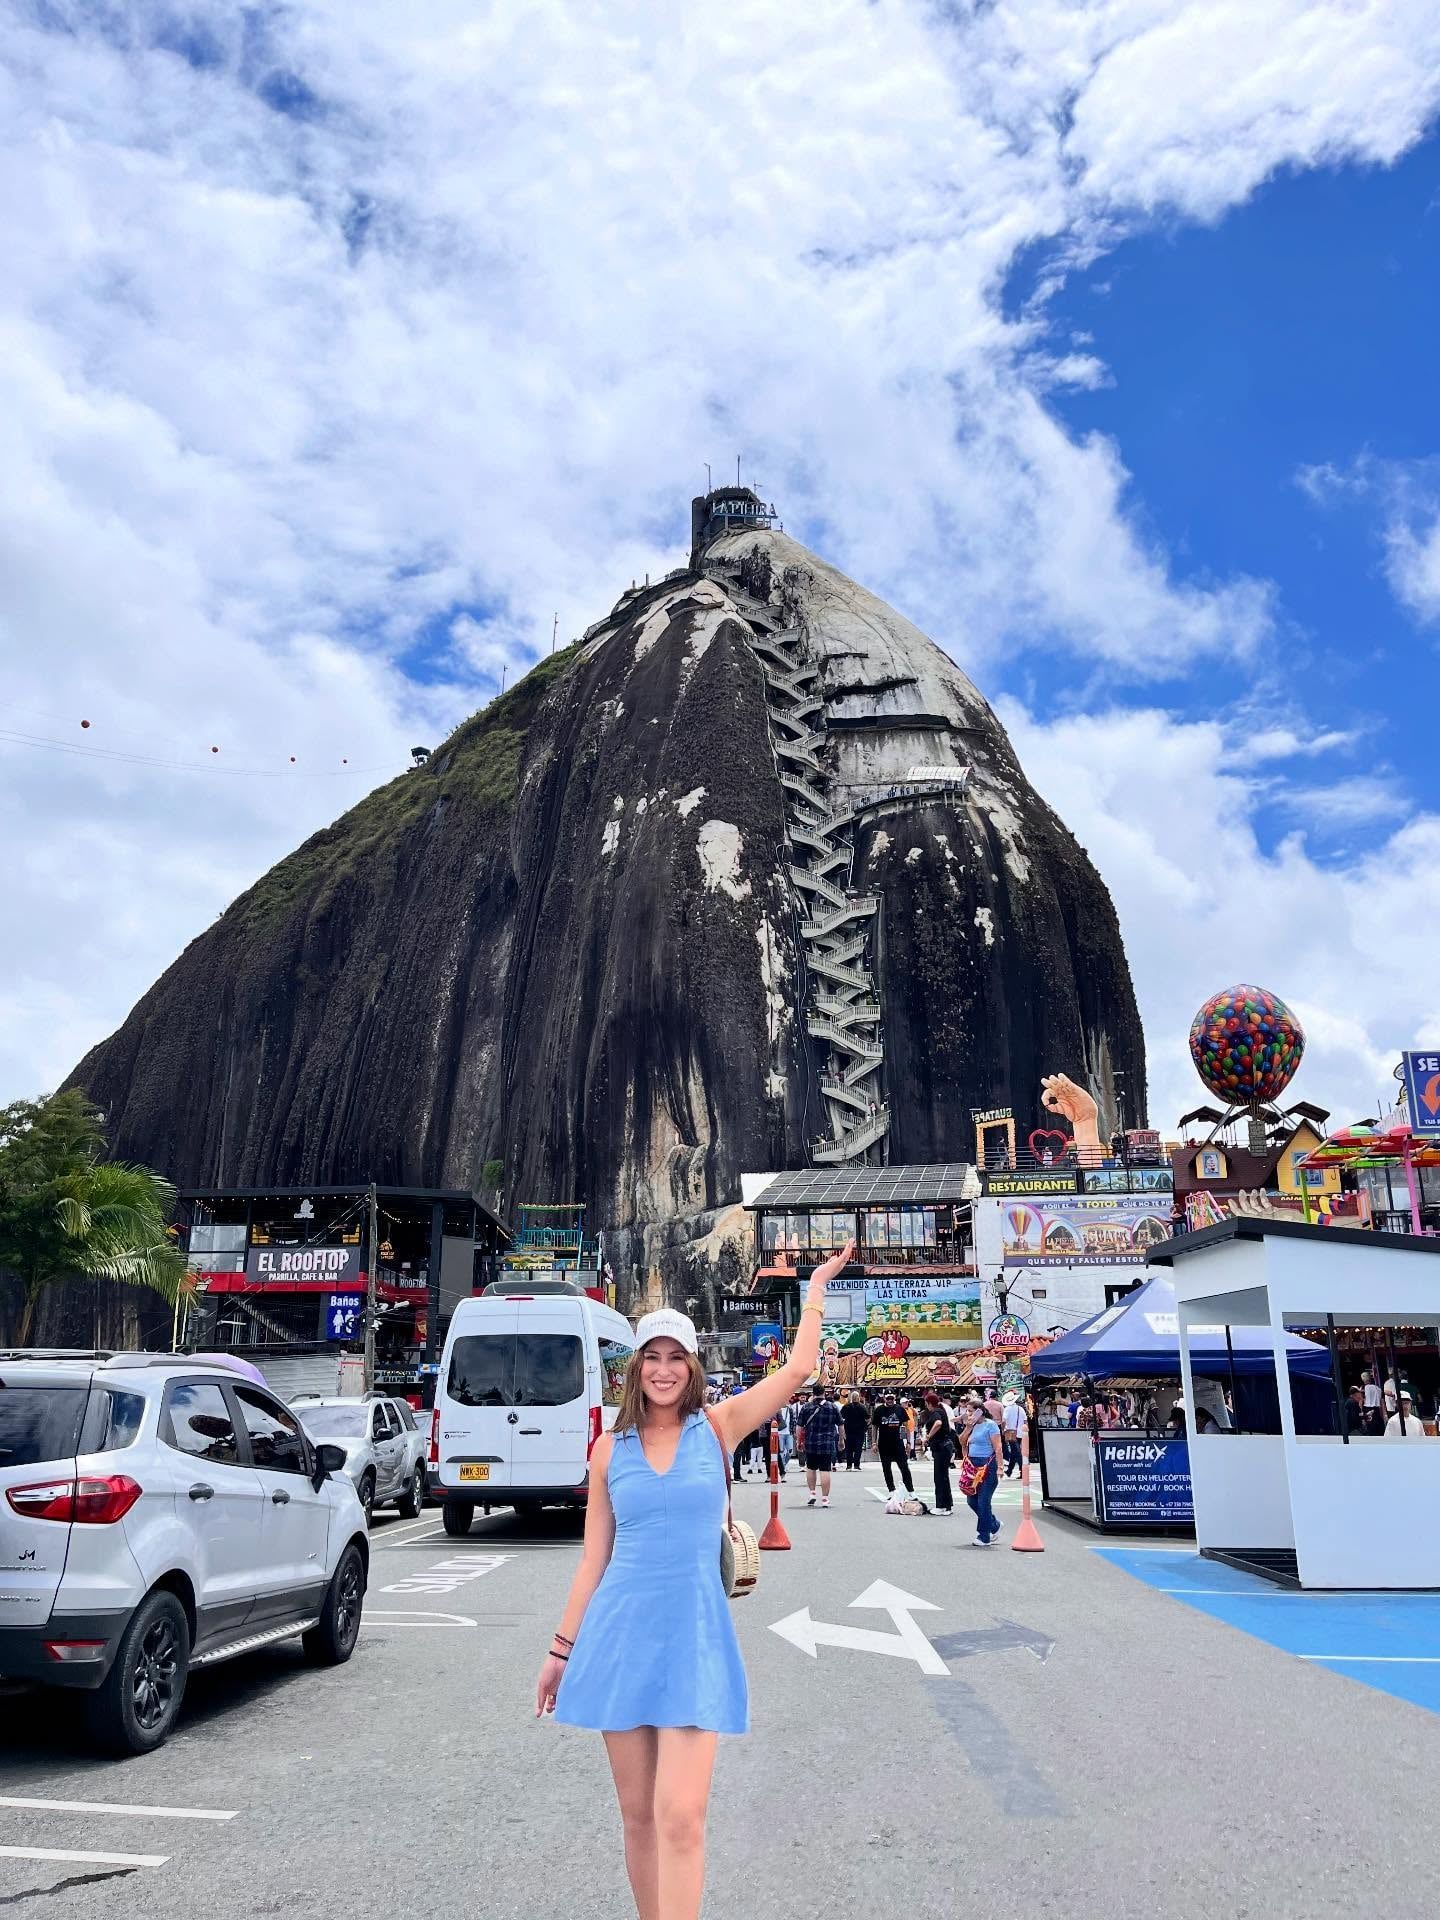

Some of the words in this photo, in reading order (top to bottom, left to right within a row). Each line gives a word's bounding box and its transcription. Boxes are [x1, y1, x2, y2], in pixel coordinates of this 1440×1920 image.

[988, 1180, 1076, 1192] RESTAURANTE
[1086, 1200, 1118, 1209] FOTOS
[1123, 1200, 1138, 1208] QUE
[257, 1252, 277, 1272] EL
[280, 1249, 350, 1272] ROOFTOP
[1027, 1258, 1046, 1266] QUE
[1048, 1257, 1062, 1265] NO
[1078, 1256, 1112, 1264] FALTEN
[325, 1272, 338, 1281] BAR
[873, 1280, 879, 1290] A
[881, 1280, 891, 1289] LA
[894, 1280, 931, 1289] TERRAZA
[935, 1279, 952, 1288] VIP
[877, 1289, 893, 1299] LAS
[897, 1289, 928, 1299] LETRAS
[330, 1295, 360, 1307] Baños
[729, 1300, 755, 1311] Baños
[990, 1332, 1028, 1347] Paisa
[1117, 1474, 1137, 1482] TOUR
[1138, 1474, 1148, 1482] EN
[1149, 1473, 1191, 1482] HELICÓPTER
[1107, 1484, 1137, 1492] RESERVA
[1138, 1483, 1157, 1492] AQUÍ
[1163, 1484, 1185, 1492] BOOK
[378, 1554, 521, 1594] SALIDA
